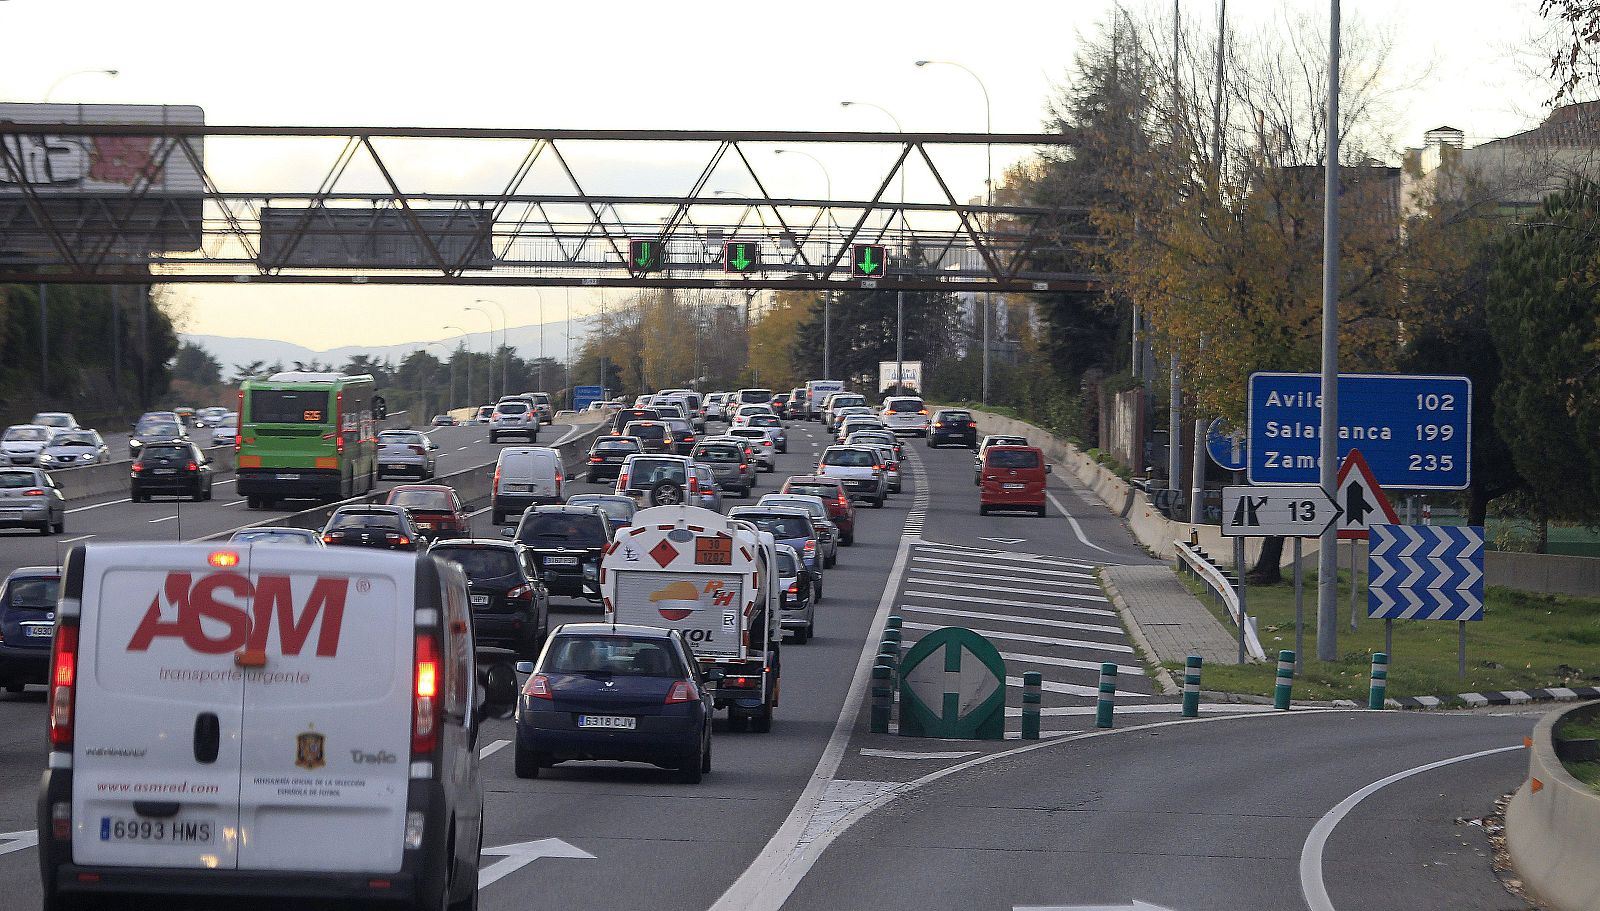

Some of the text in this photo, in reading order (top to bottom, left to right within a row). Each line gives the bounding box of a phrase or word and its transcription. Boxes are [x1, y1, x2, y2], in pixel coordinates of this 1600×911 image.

[1417, 394, 1454, 410] 102
[1265, 421, 1454, 441] Salaanca 199
[1409, 454, 1453, 471] 235
[1288, 501, 1316, 522] 13
[709, 540, 720, 550] 30
[126, 571, 350, 657] ASM
[159, 666, 310, 685] transporte urgente
[585, 716, 611, 727] 6318
[97, 781, 219, 794] www.asmred.com
[114, 821, 210, 841] 6993 HMS
